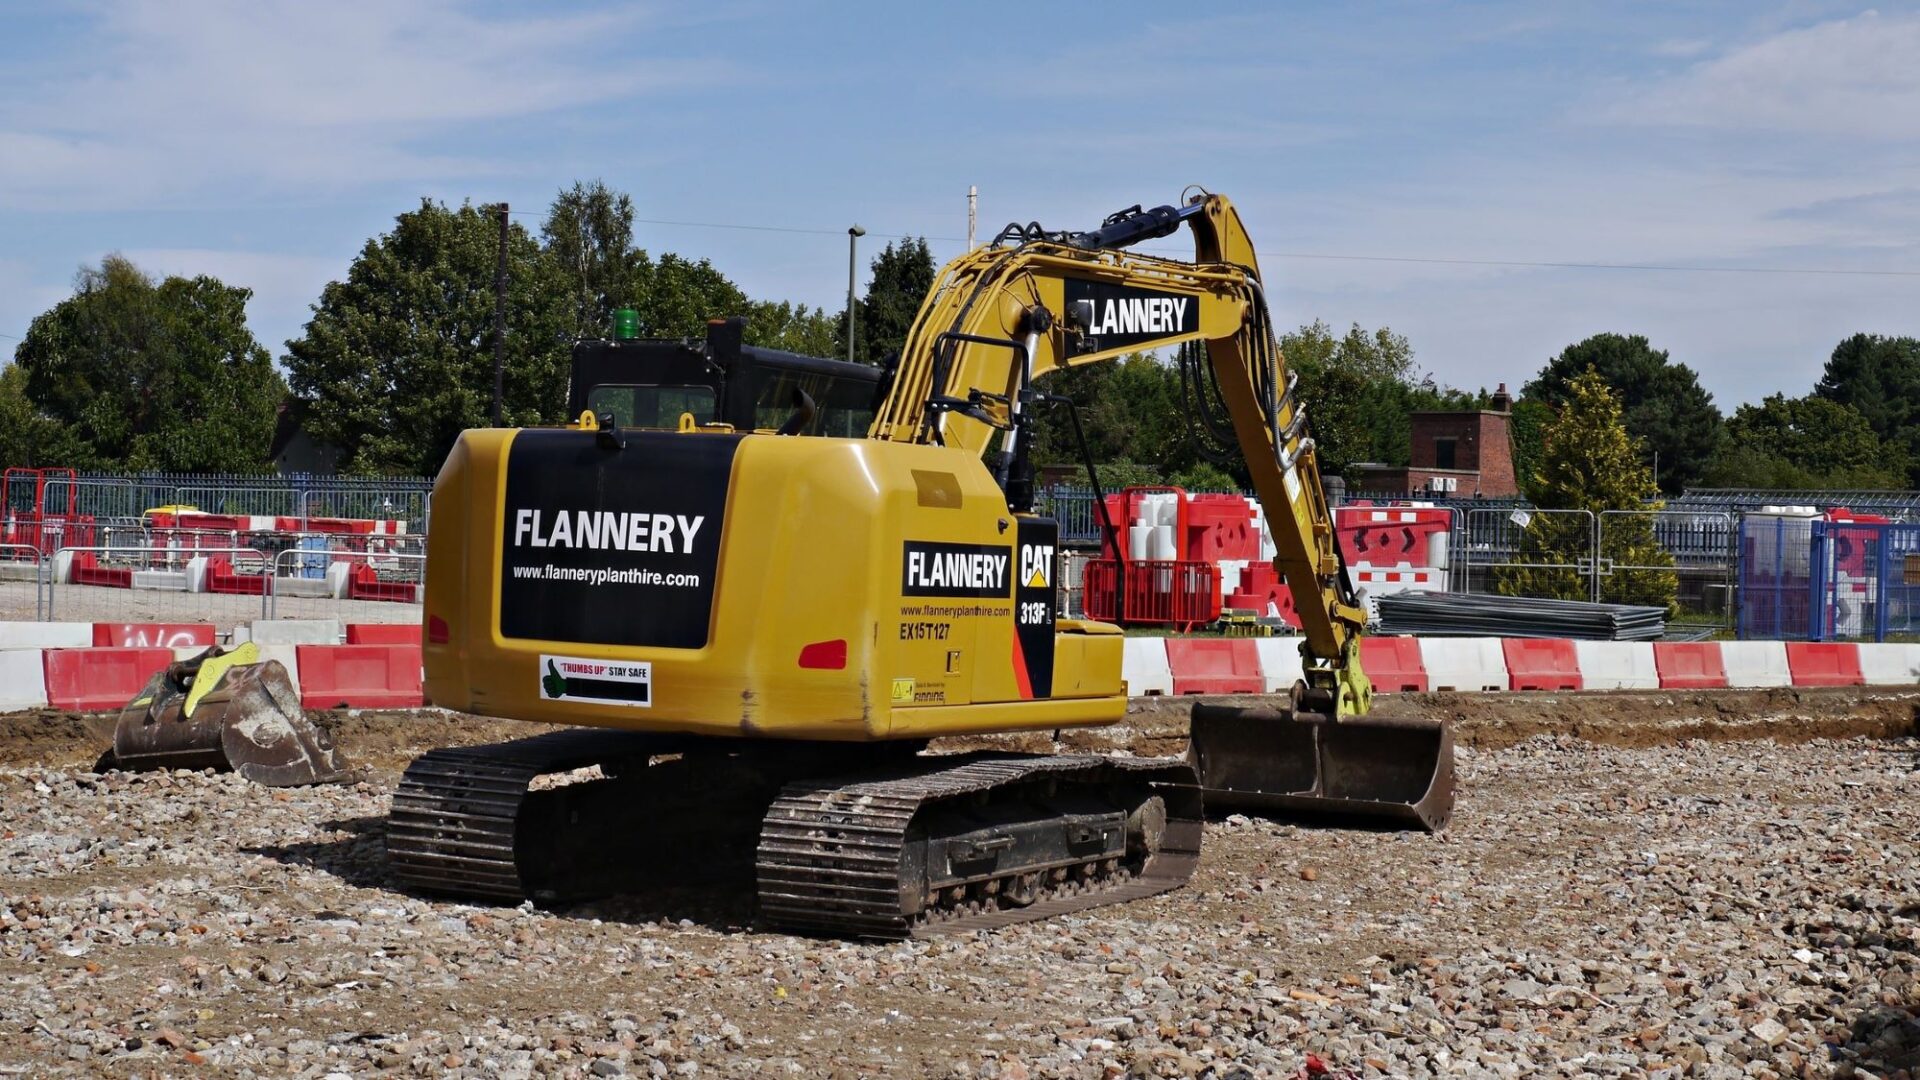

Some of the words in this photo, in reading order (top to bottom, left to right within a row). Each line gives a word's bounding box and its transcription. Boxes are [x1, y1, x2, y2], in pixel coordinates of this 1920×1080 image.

[1077, 297, 1188, 335] LANNERY
[515, 509, 705, 554] FLANNERY
[513, 564, 700, 588] www.flanneryplanthire.com
[908, 551, 1007, 589] FLANNERY
[1021, 543, 1054, 588] CAT
[900, 605, 1011, 619] www.flanneryplanthire.com
[1020, 602, 1046, 625] 313F
[900, 622, 950, 641] EX15T127
[608, 666, 627, 676] STAY
[628, 667, 647, 678] SAFE
